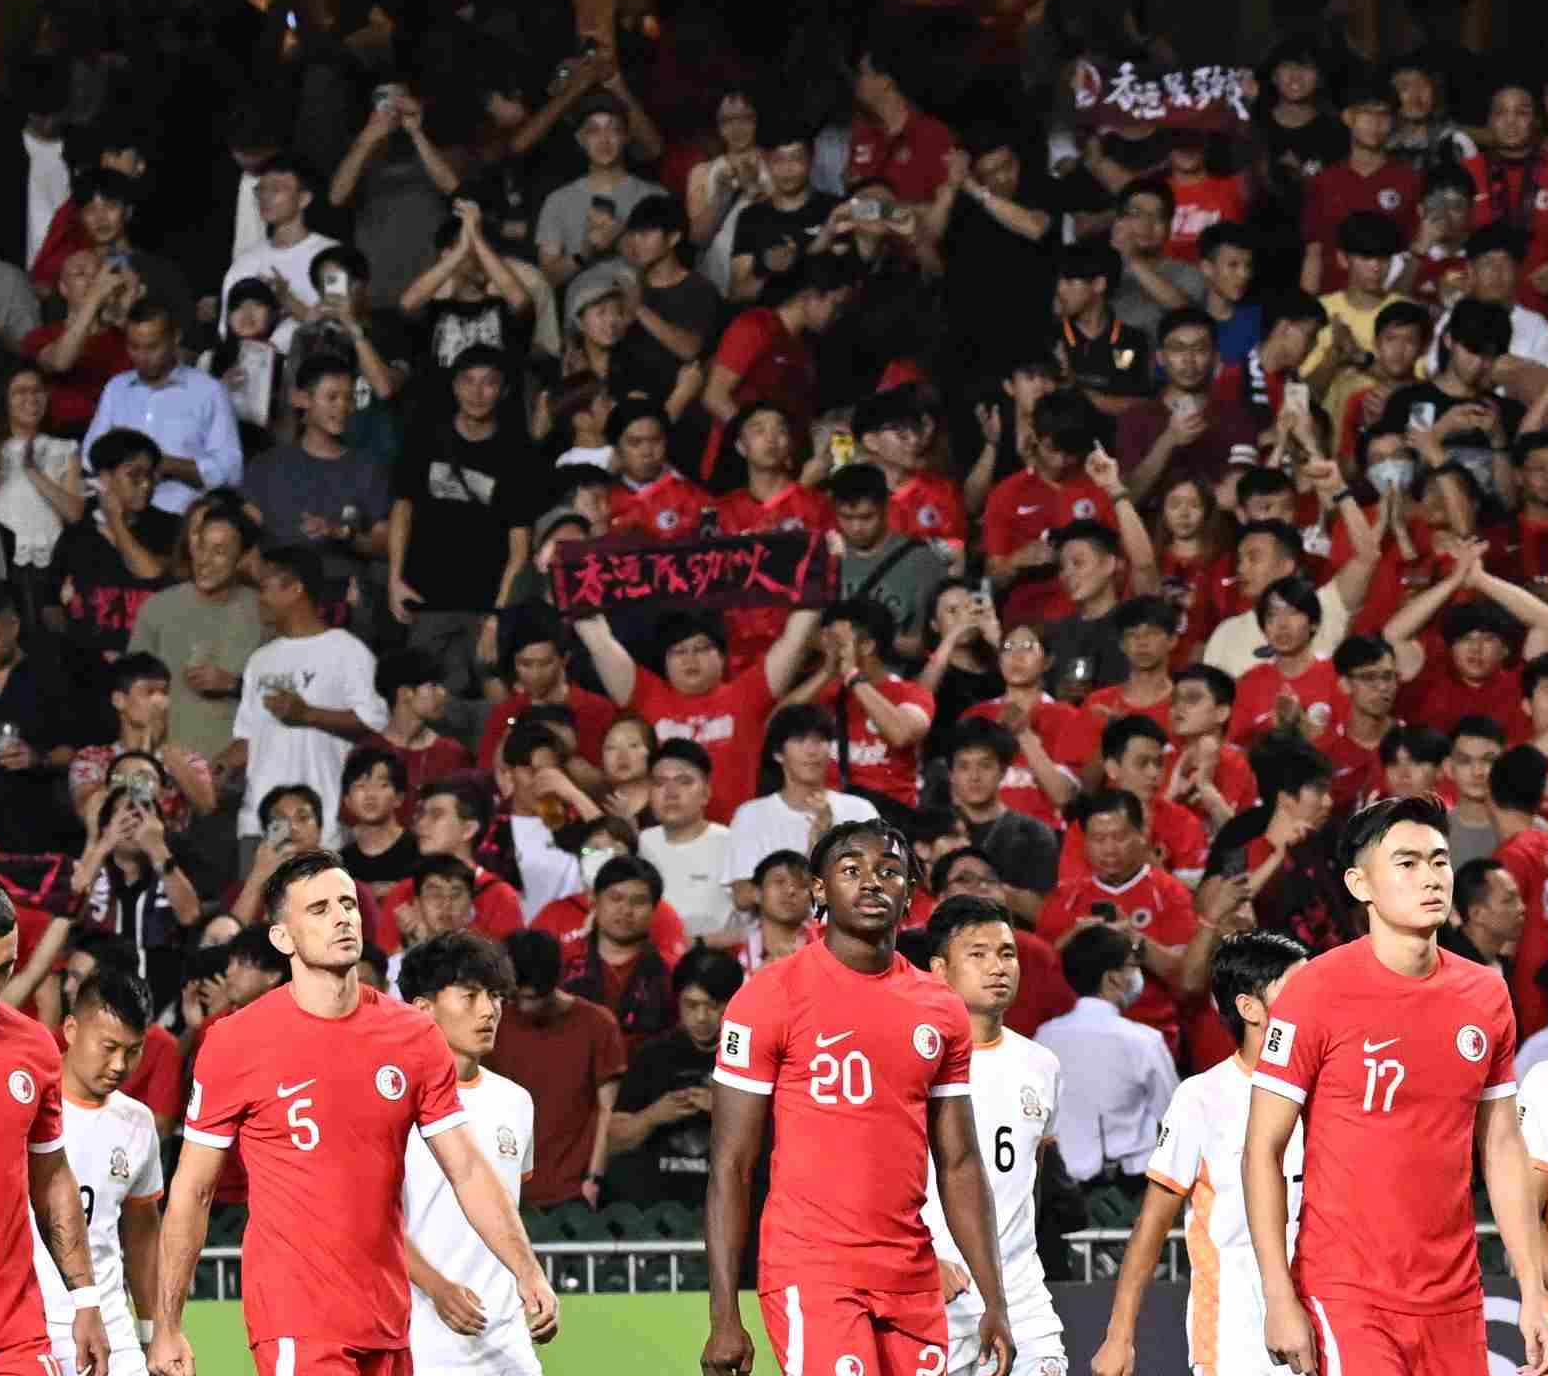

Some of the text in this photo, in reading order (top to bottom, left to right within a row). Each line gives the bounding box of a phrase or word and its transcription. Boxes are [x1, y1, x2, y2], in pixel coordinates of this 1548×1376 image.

[809, 1051, 872, 1104] 20
[1363, 1059, 1404, 1111] 17
[288, 1099, 319, 1151] 5
[995, 1126, 1014, 1172] 6
